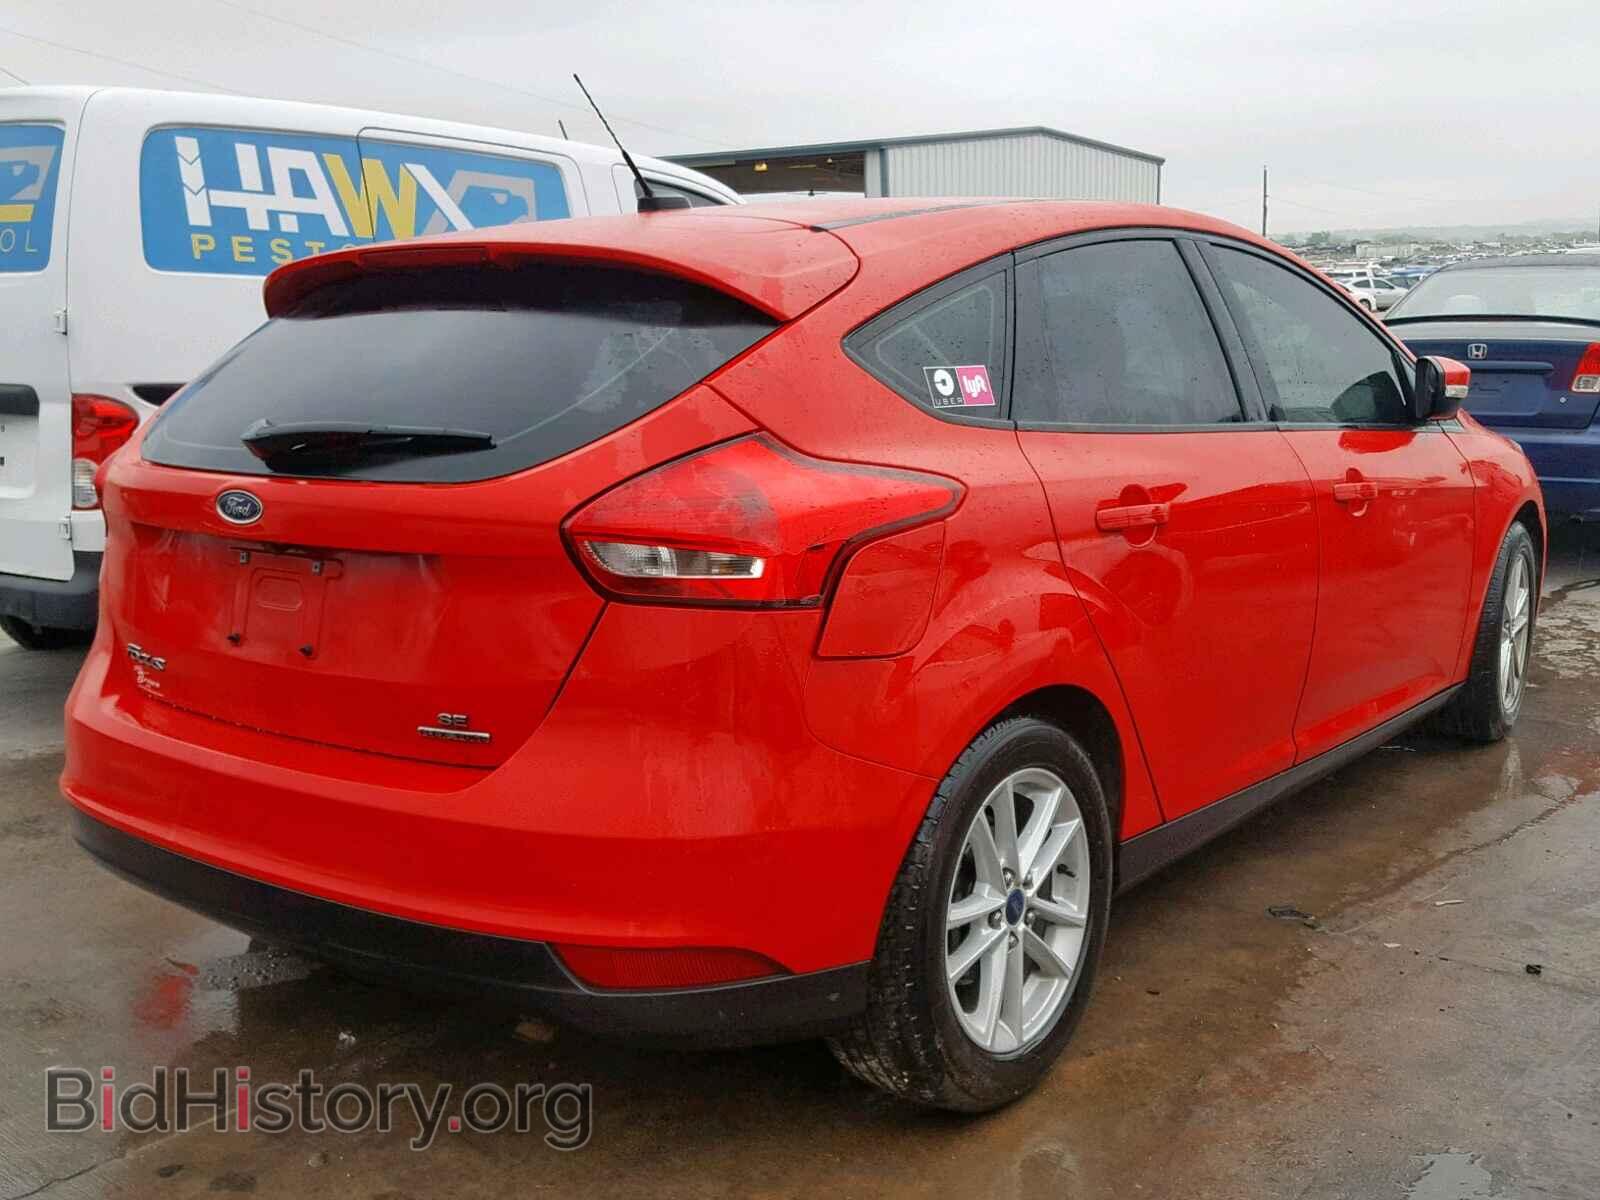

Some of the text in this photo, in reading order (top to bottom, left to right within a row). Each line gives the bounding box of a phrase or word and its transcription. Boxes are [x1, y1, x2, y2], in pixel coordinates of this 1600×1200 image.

[935, 397, 963, 406] UBER
[224, 496, 252, 517] Ford
[437, 712, 468, 727] SE
